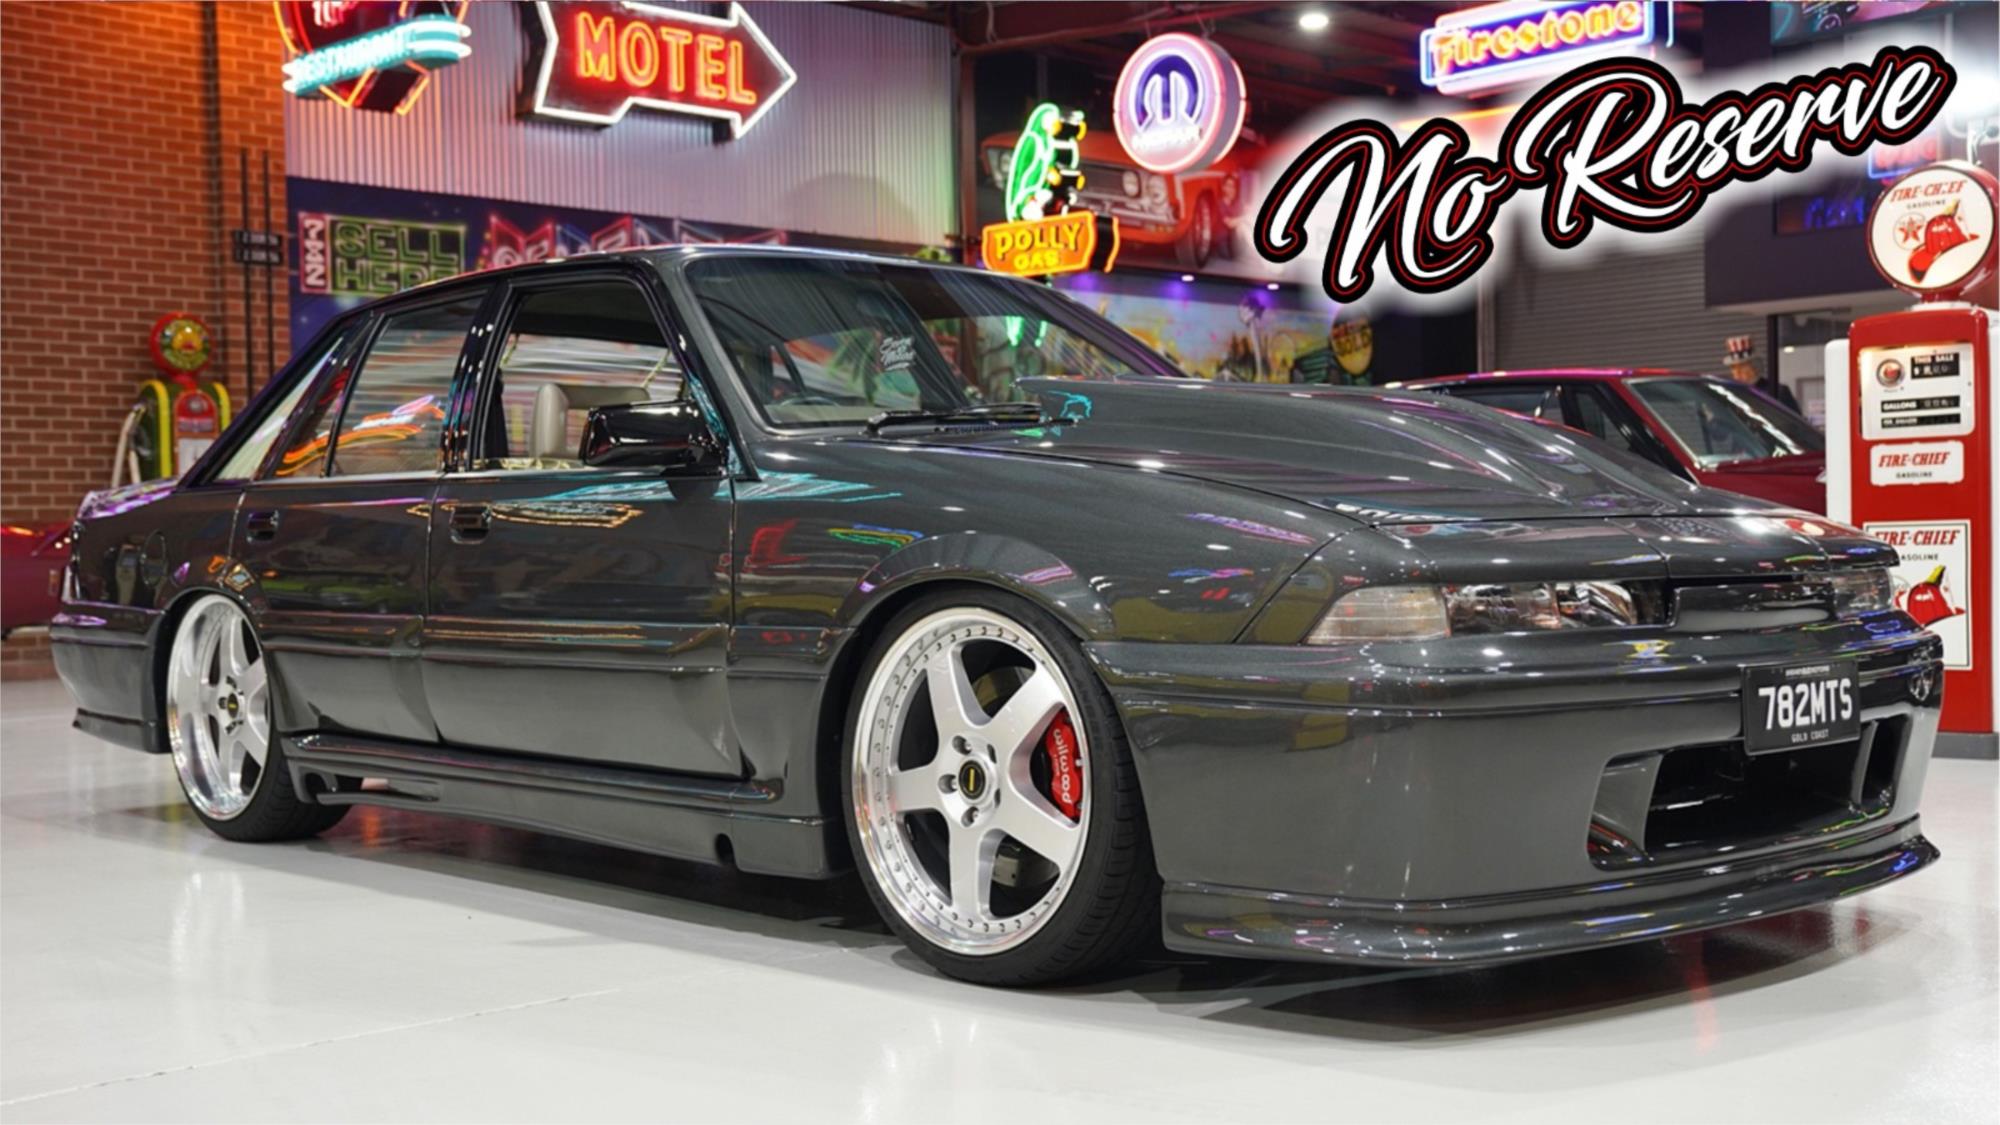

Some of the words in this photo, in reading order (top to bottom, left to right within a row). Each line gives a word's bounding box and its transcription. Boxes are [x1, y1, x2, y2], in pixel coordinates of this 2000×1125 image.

[577, 11, 757, 105] MOTEL
[1432, 1, 1642, 73] Firestone
[334, 222, 459, 264] SELL
[994, 222, 1080, 260] POLLY
[1013, 249, 1059, 270] GAS
[1879, 452, 1950, 467] FIRE-CHIEF
[1900, 553, 1939, 561] ASOLINE
[1758, 678, 1852, 730] 782MTS
[1053, 729, 1073, 804] wilwood
